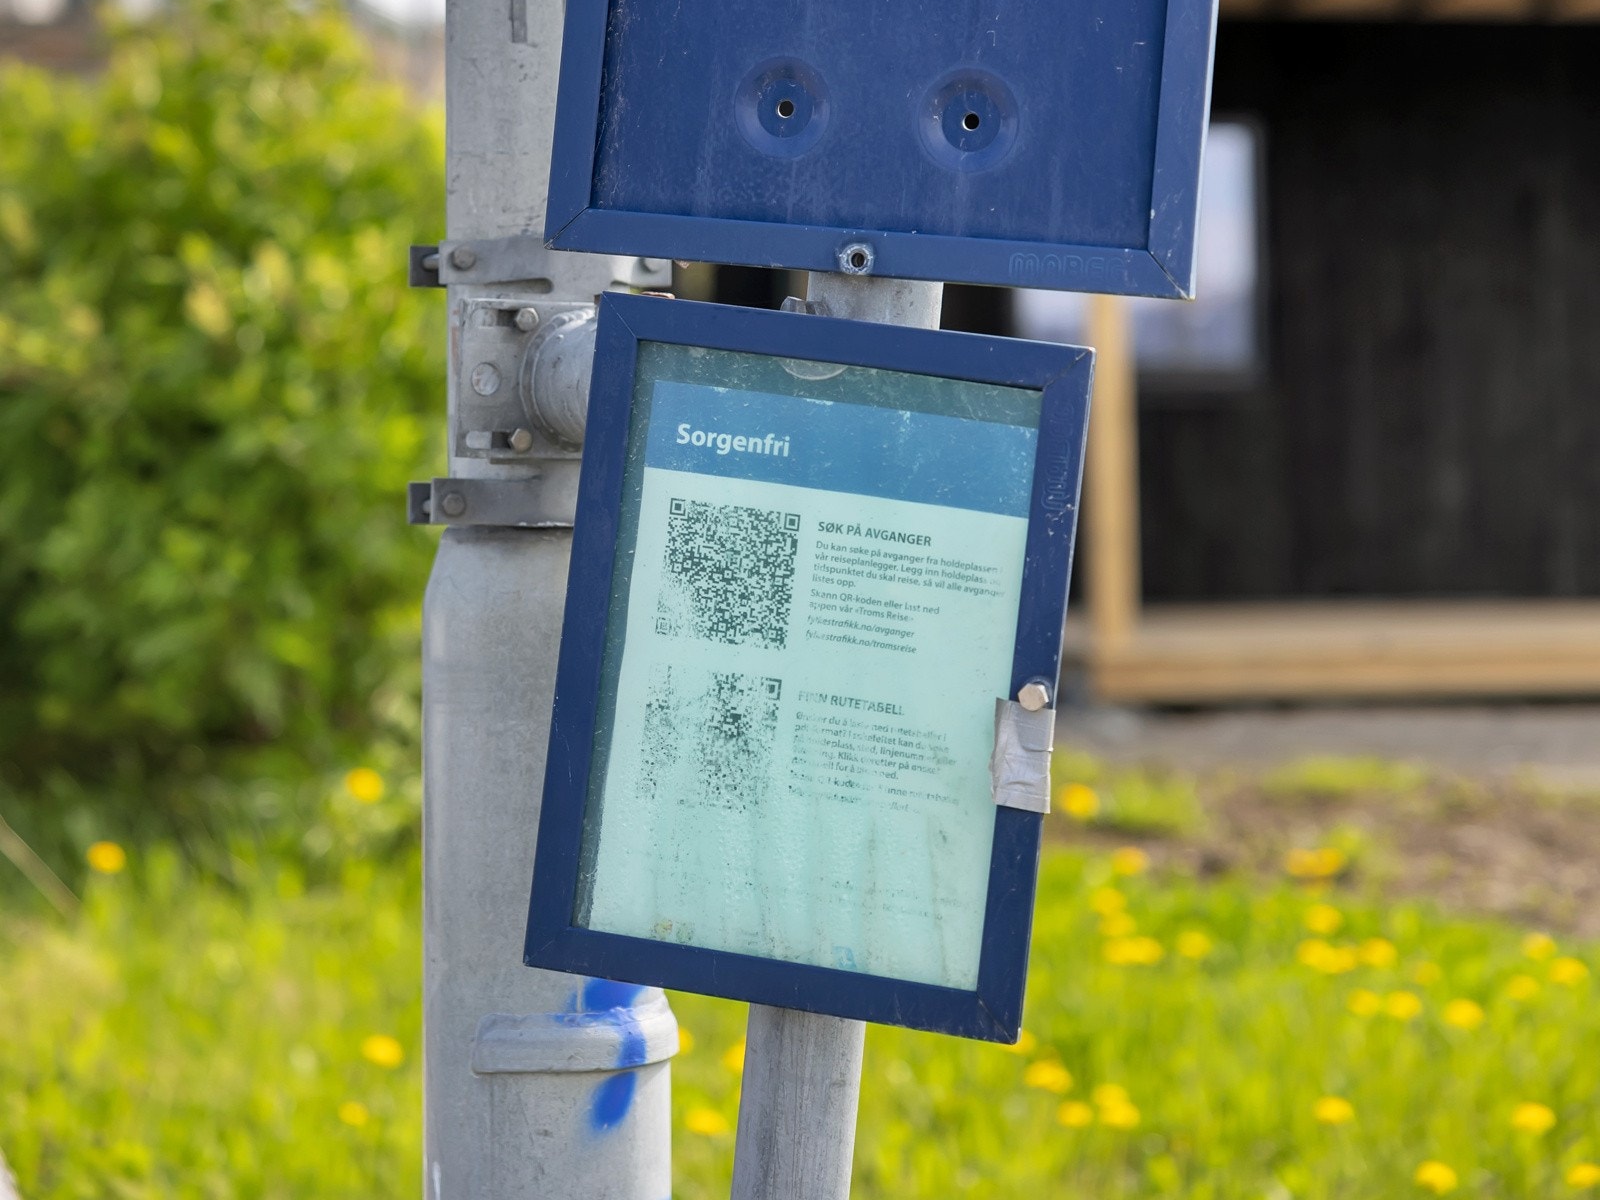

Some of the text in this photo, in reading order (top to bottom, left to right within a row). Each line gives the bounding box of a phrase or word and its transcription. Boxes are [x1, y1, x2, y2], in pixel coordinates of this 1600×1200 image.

[676, 423, 790, 457] Sorgenfri
[818, 521, 932, 547] SØK PÅ AVGANGER
[816, 540, 829, 550] Du
[830, 542, 847, 553] kan
[849, 546, 870, 556] søke
[870, 549, 881, 558] på
[883, 552, 925, 564] avganger
[926, 556, 938, 565] fra
[815, 552, 829, 561] vår
[830, 555, 899, 572] reiseplanlegger.
[900, 564, 923, 576] Legg
[925, 567, 939, 576] inn
[812, 574, 856, 588] listes opp.
[814, 563, 864, 577] tidspunktet
[866, 570, 877, 579] du
[879, 573, 896, 582] skal
[923, 579, 932, 587] så
[935, 580, 945, 589] vil
[946, 582, 962, 591] alle
[810, 589, 837, 600] Skann
[840, 593, 882, 606] QR-koden
[884, 600, 903, 609] eller
[923, 606, 940, 615] ned
[839, 604, 853, 613] vår
[805, 629, 917, 654] fylstrafikk.no/tromsreise
[830, 695, 904, 715] RUTETABELL
[829, 716, 841, 725] du
[898, 738, 914, 748] kan
[836, 762, 848, 771] for
[898, 761, 909, 770] på
